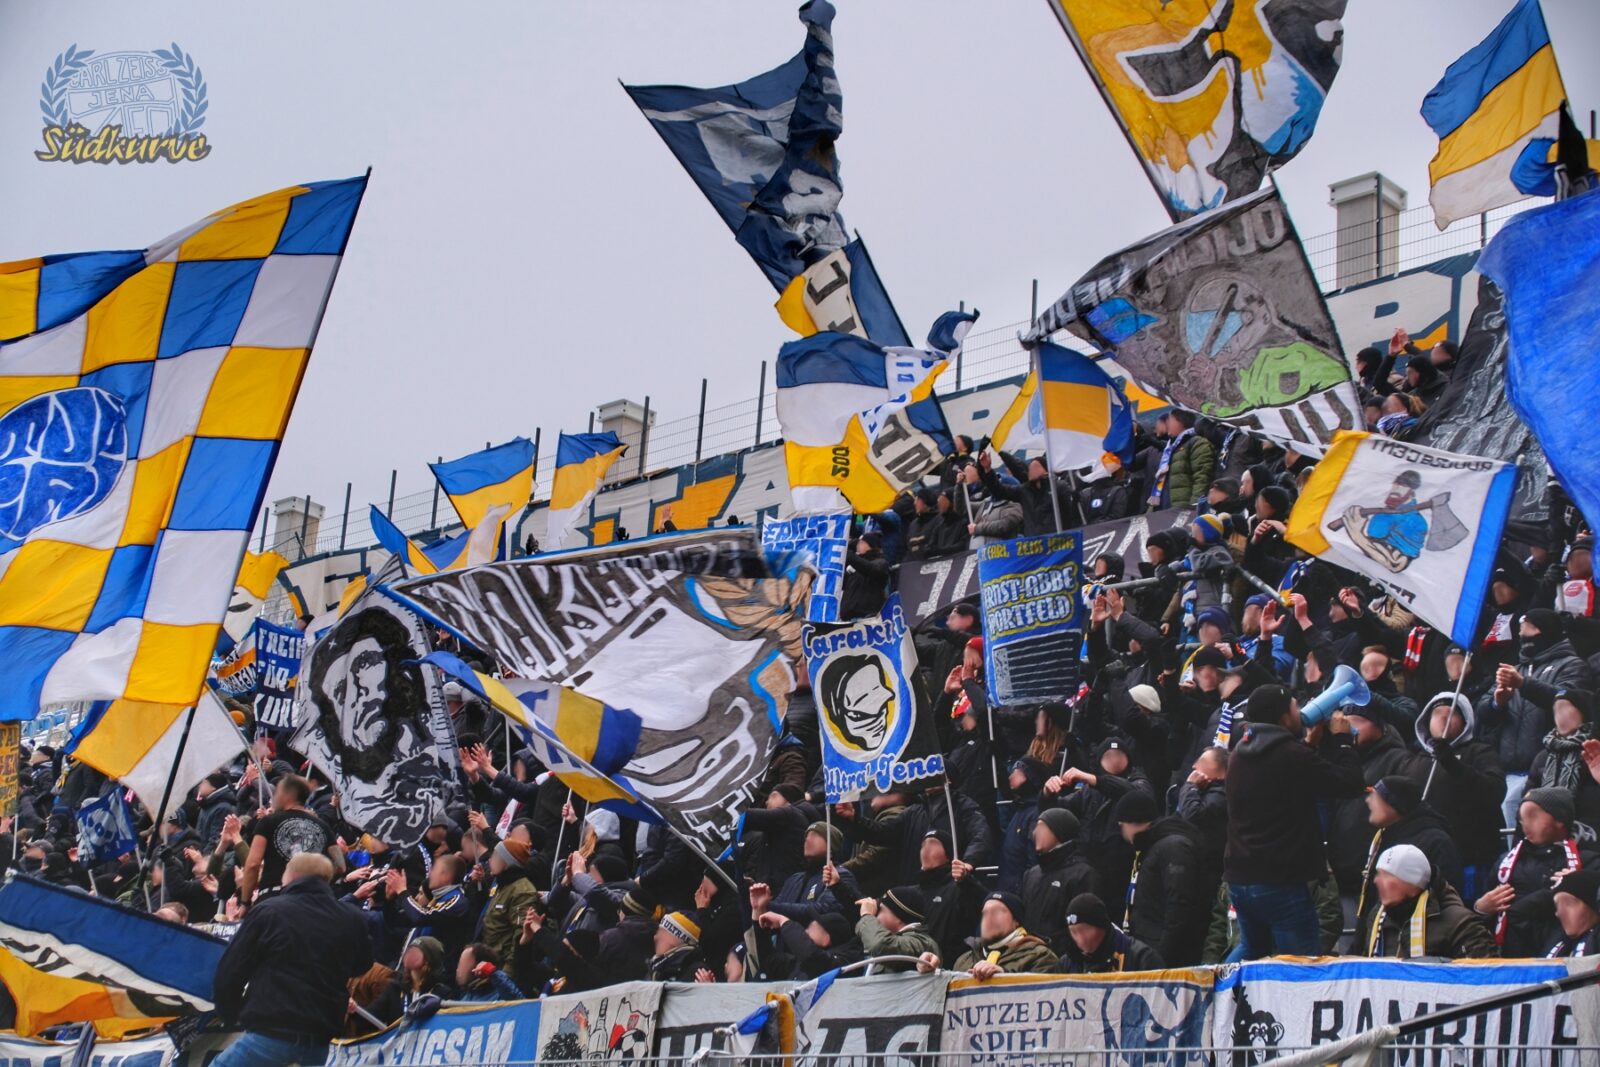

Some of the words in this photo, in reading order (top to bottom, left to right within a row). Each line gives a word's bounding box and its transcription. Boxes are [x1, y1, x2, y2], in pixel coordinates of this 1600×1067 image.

[875, 752, 945, 793] Jena
[947, 1002, 1030, 1031] NUTZE
[1035, 998, 1087, 1023] DAS
